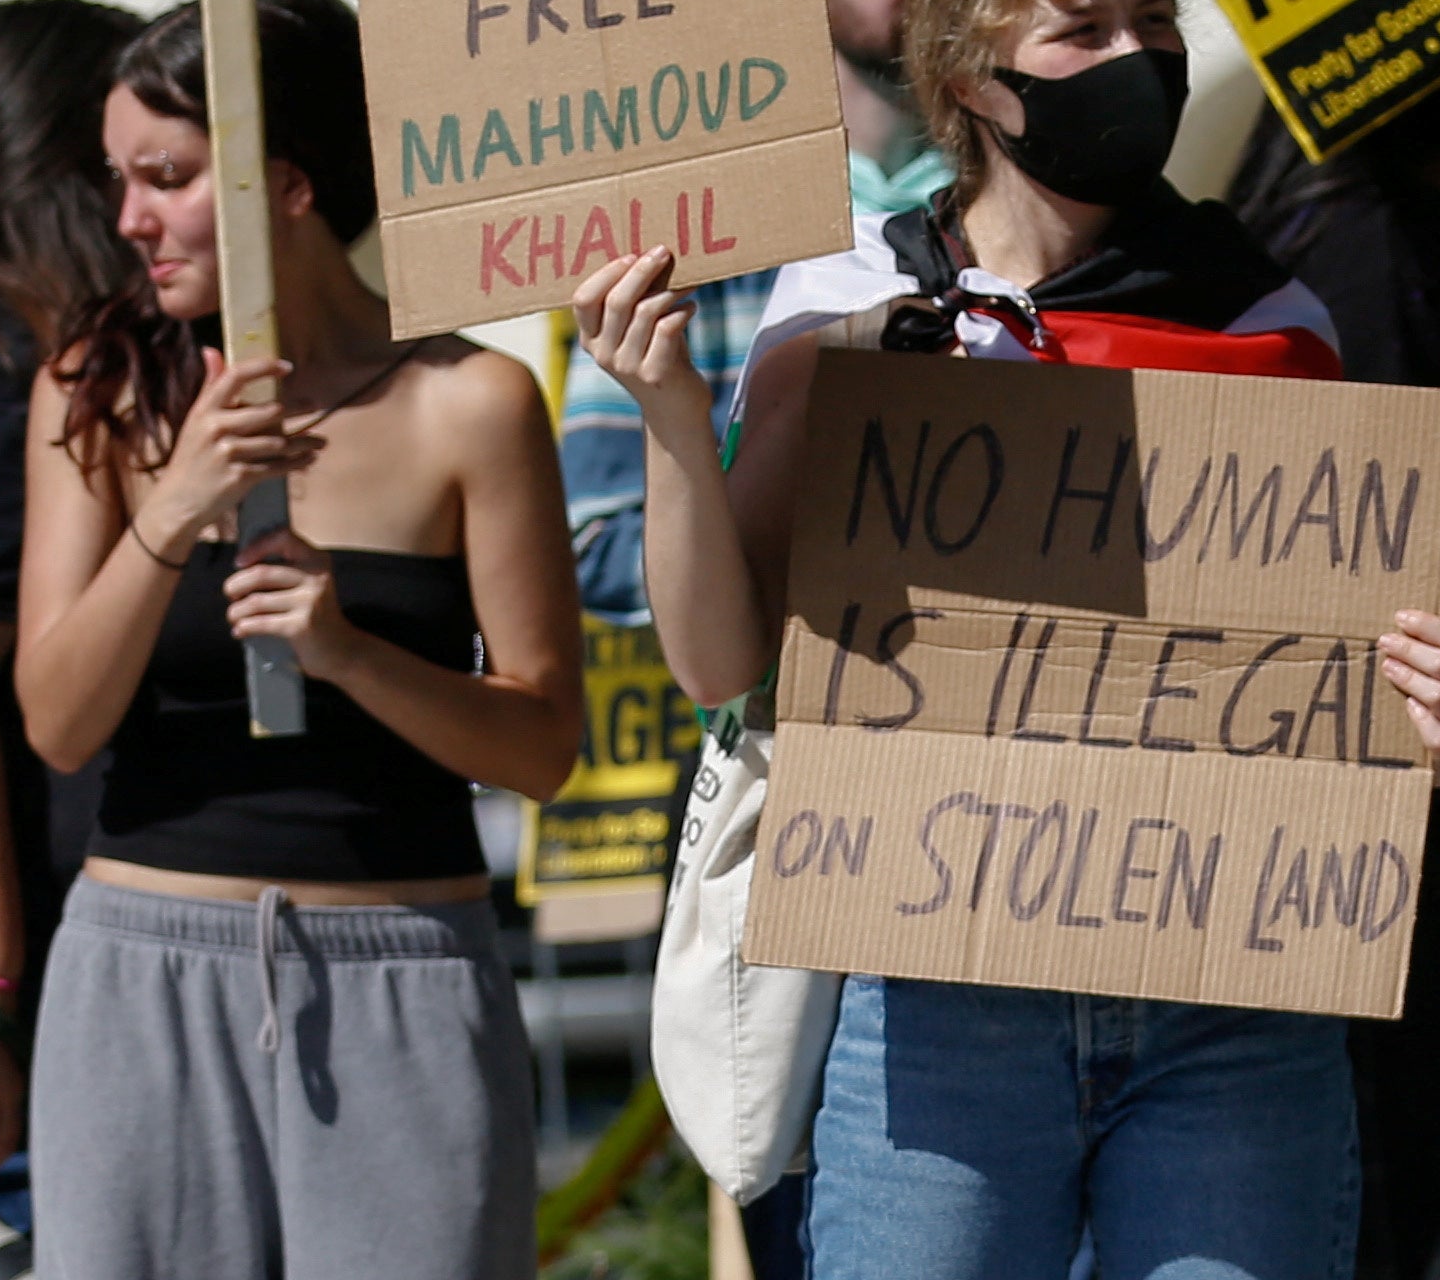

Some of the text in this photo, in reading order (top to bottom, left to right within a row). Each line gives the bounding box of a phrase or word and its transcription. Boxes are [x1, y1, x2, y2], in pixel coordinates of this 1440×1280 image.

[401, 56, 788, 198] MAHMOUD
[1288, 46, 1355, 97] Party
[1344, 27, 1383, 61] for
[1312, 49, 1424, 129] Liberation
[847, 416, 1421, 576] NO HUMAN
[823, 602, 945, 732] IS
[986, 612, 1414, 770] ILLEGAL
[773, 792, 1410, 953] ON STOLEN LAND
